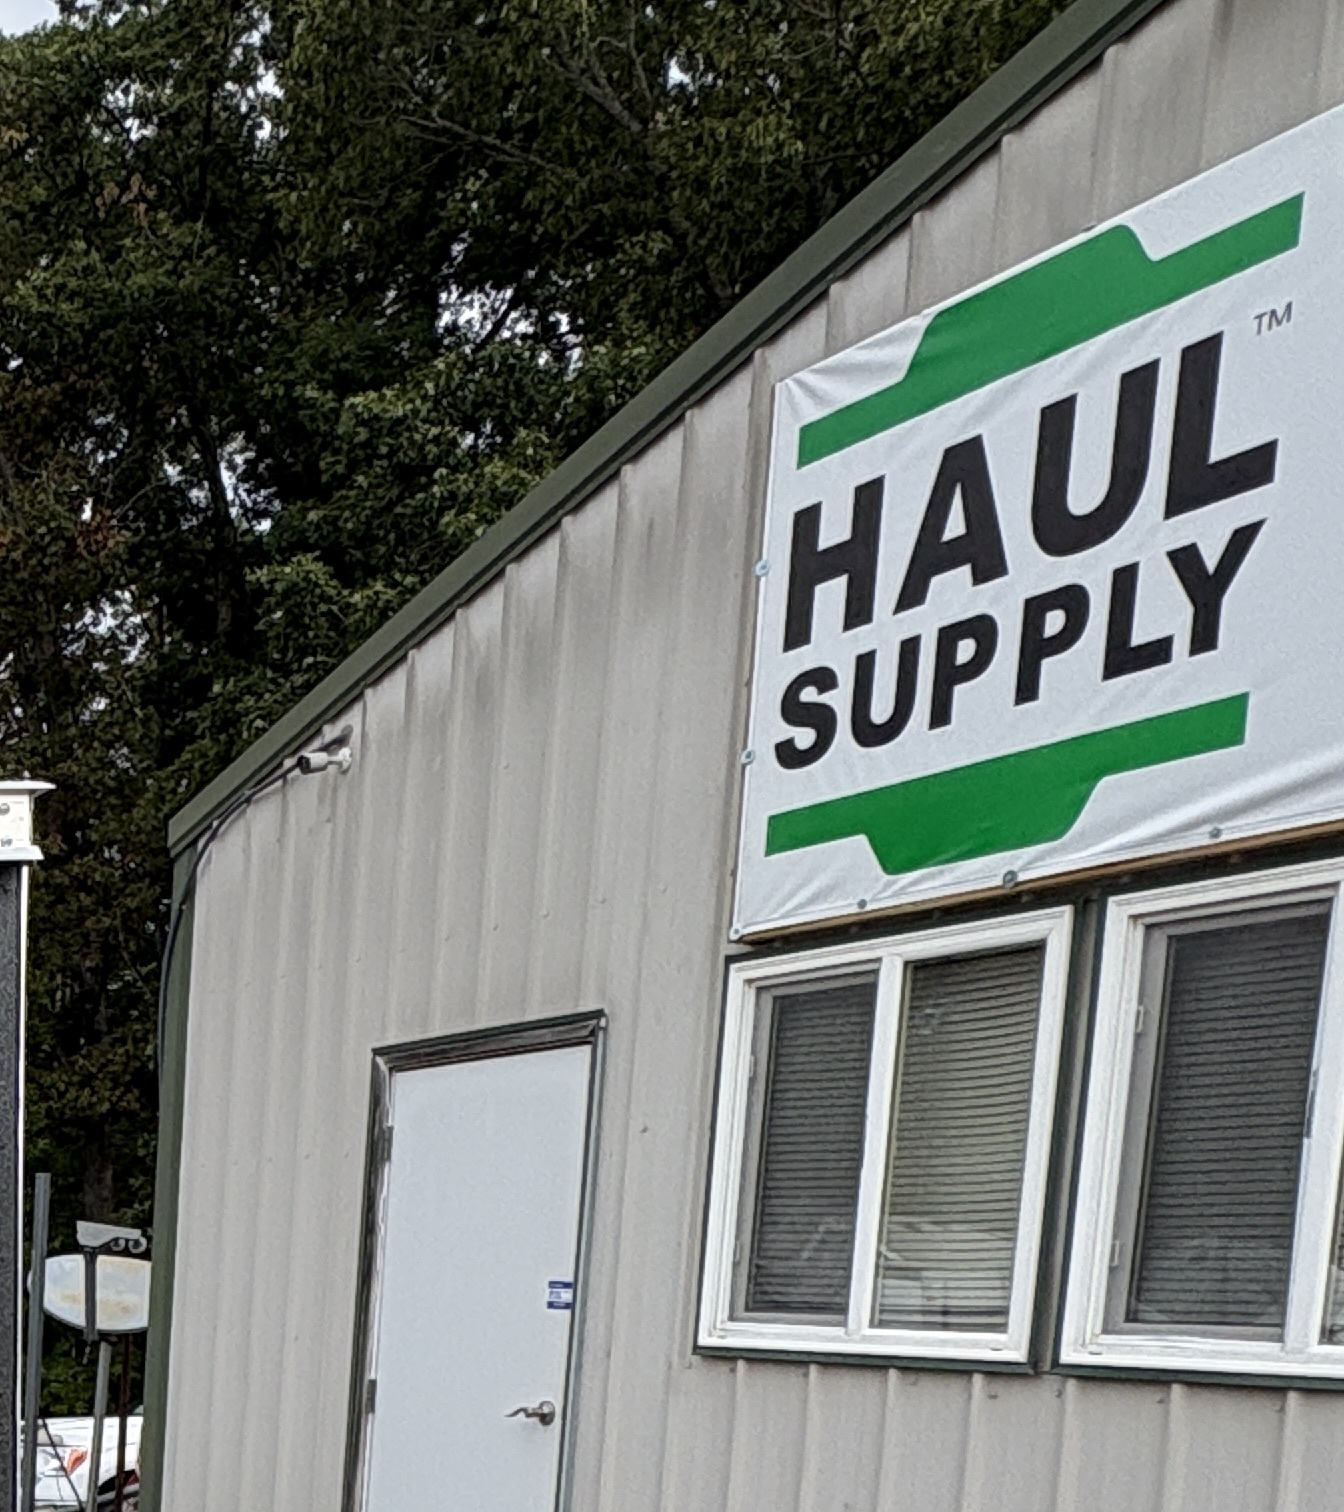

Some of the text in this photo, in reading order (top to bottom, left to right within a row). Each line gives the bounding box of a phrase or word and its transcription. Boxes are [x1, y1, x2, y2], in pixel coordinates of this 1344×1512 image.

[1252, 302, 1293, 337] TM
[783, 331, 1279, 652] HAUL
[774, 518, 1268, 771] SUPPLY
